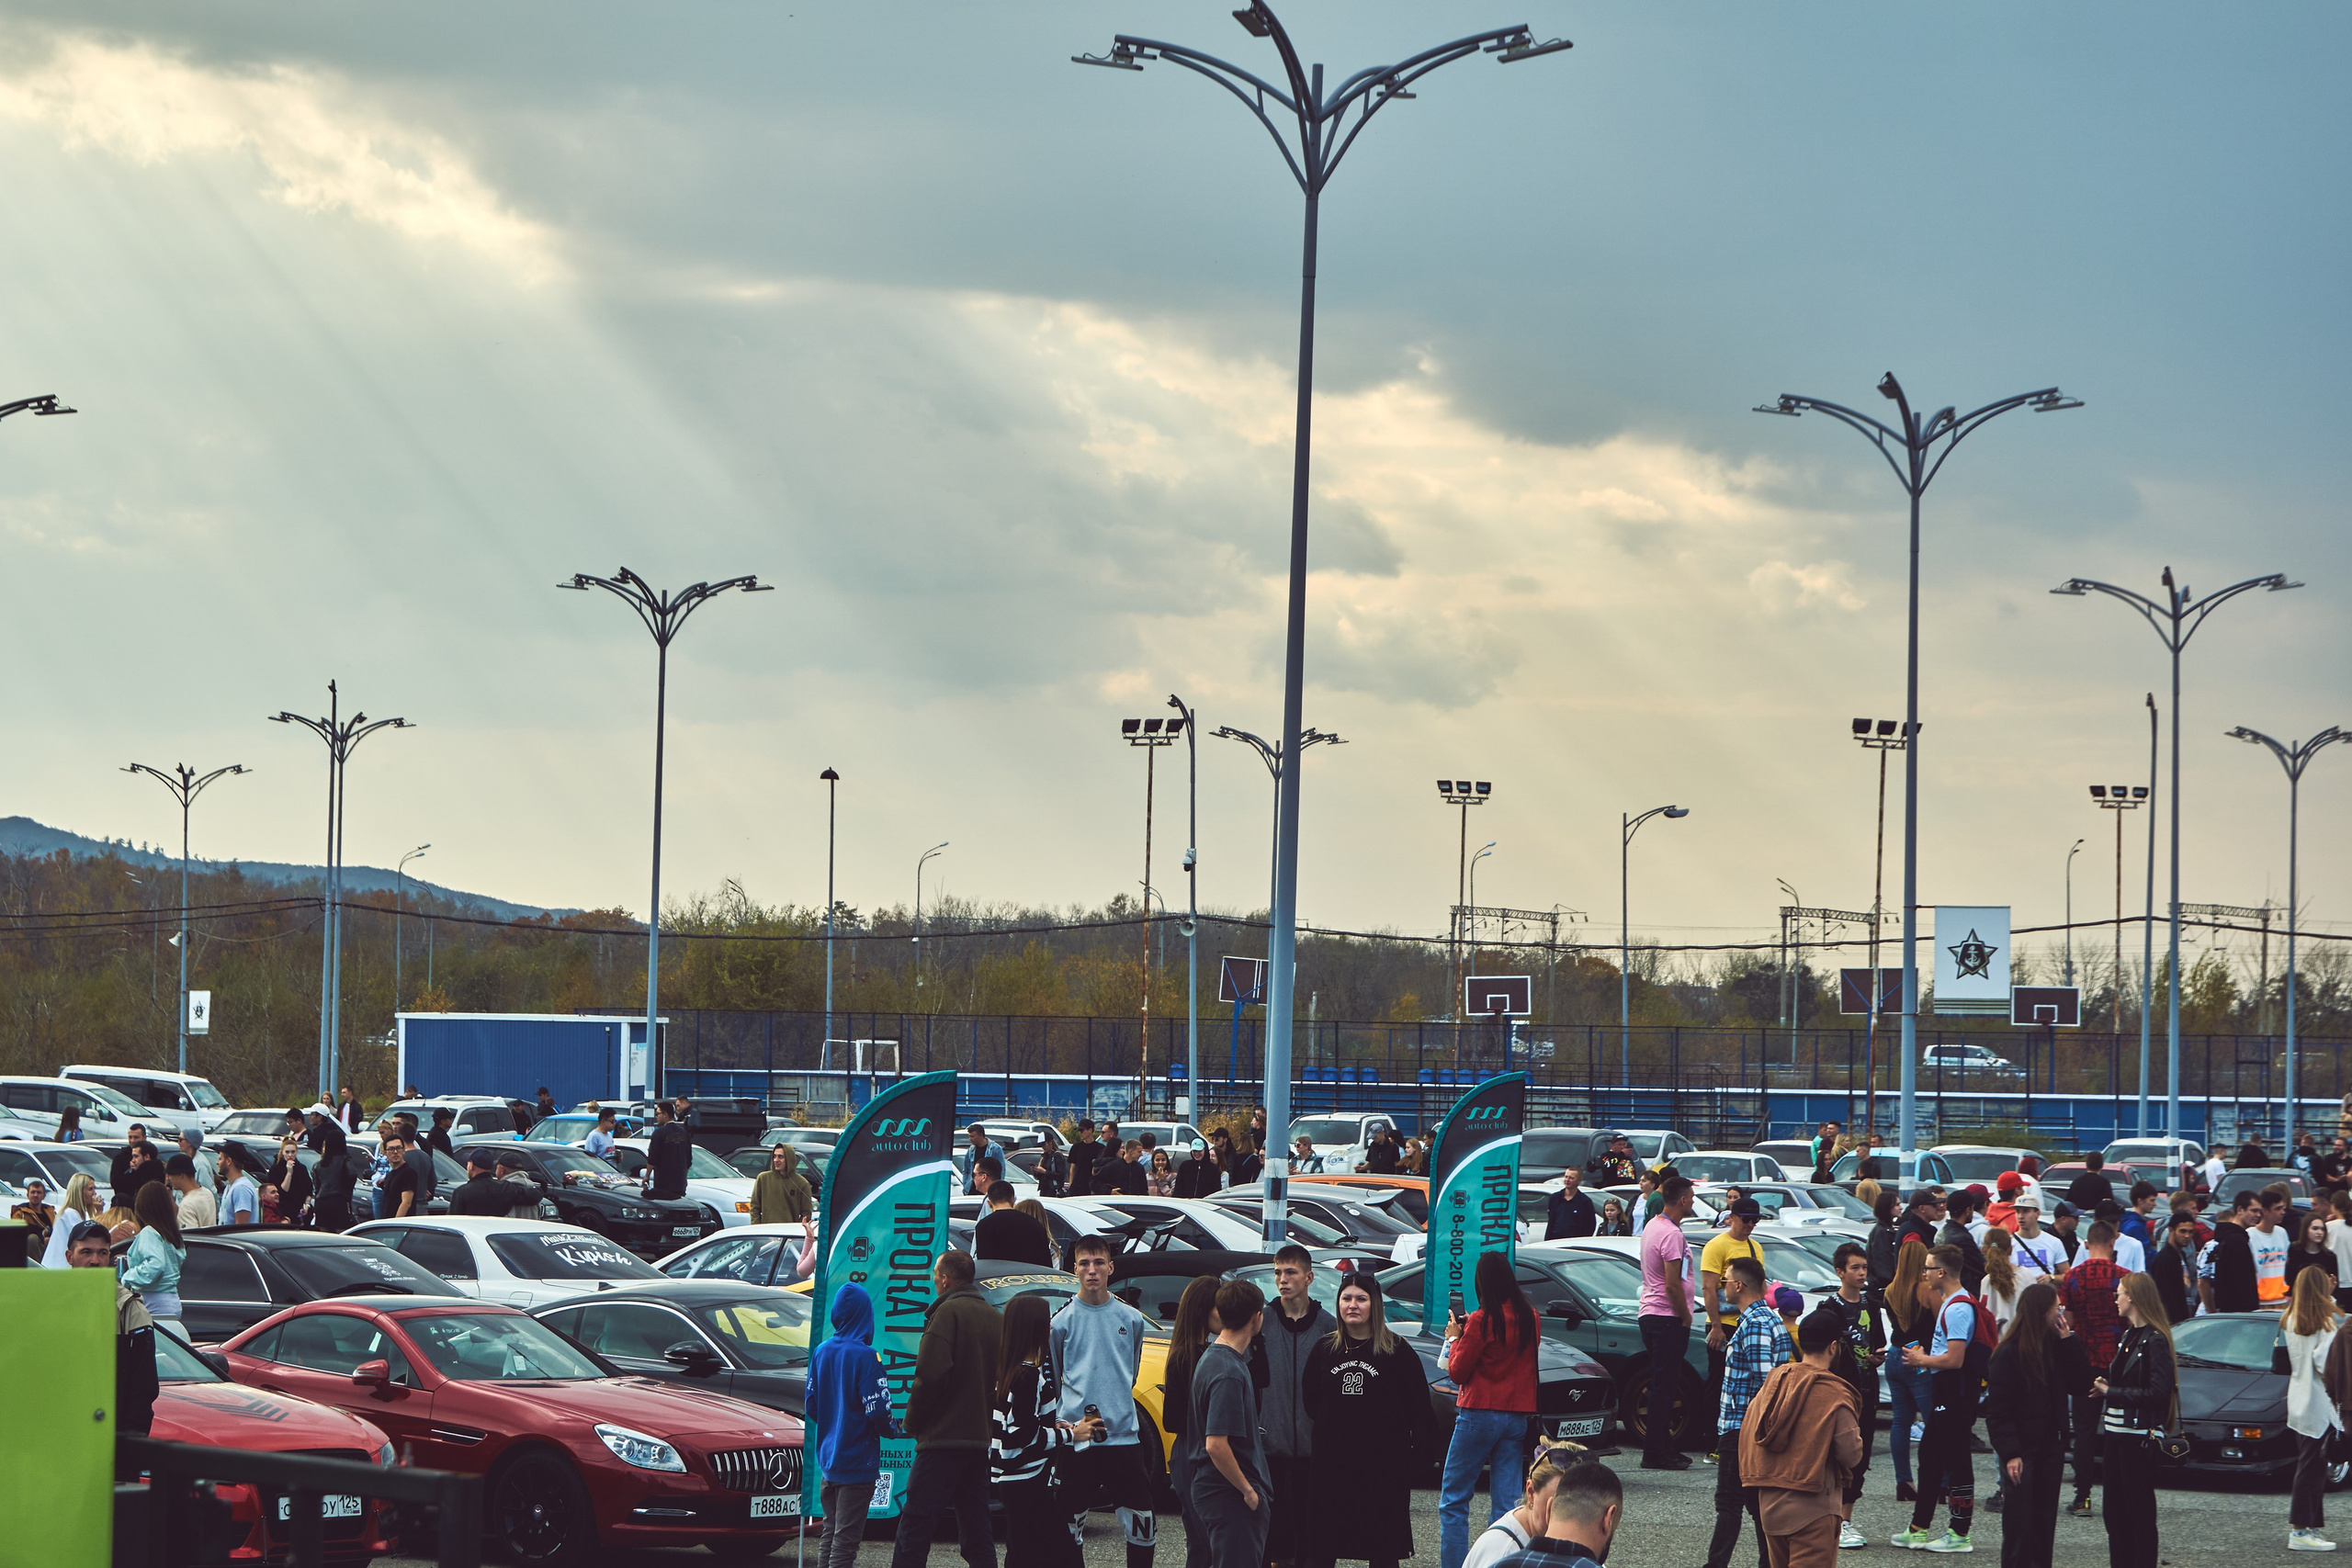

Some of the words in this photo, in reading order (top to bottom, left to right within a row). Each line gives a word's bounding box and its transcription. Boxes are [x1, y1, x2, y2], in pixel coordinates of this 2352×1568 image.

[1464, 1122, 1487, 1131] auto
[1488, 1121, 1509, 1130] club
[871, 1141, 902, 1152] auto
[904, 1139, 932, 1151] club
[554, 1246, 632, 1267] Kipish
[1448, 1213, 1465, 1292] 8-800-201
[1341, 1371, 1364, 1395] 22
[339, 1495, 360, 1509] 125
